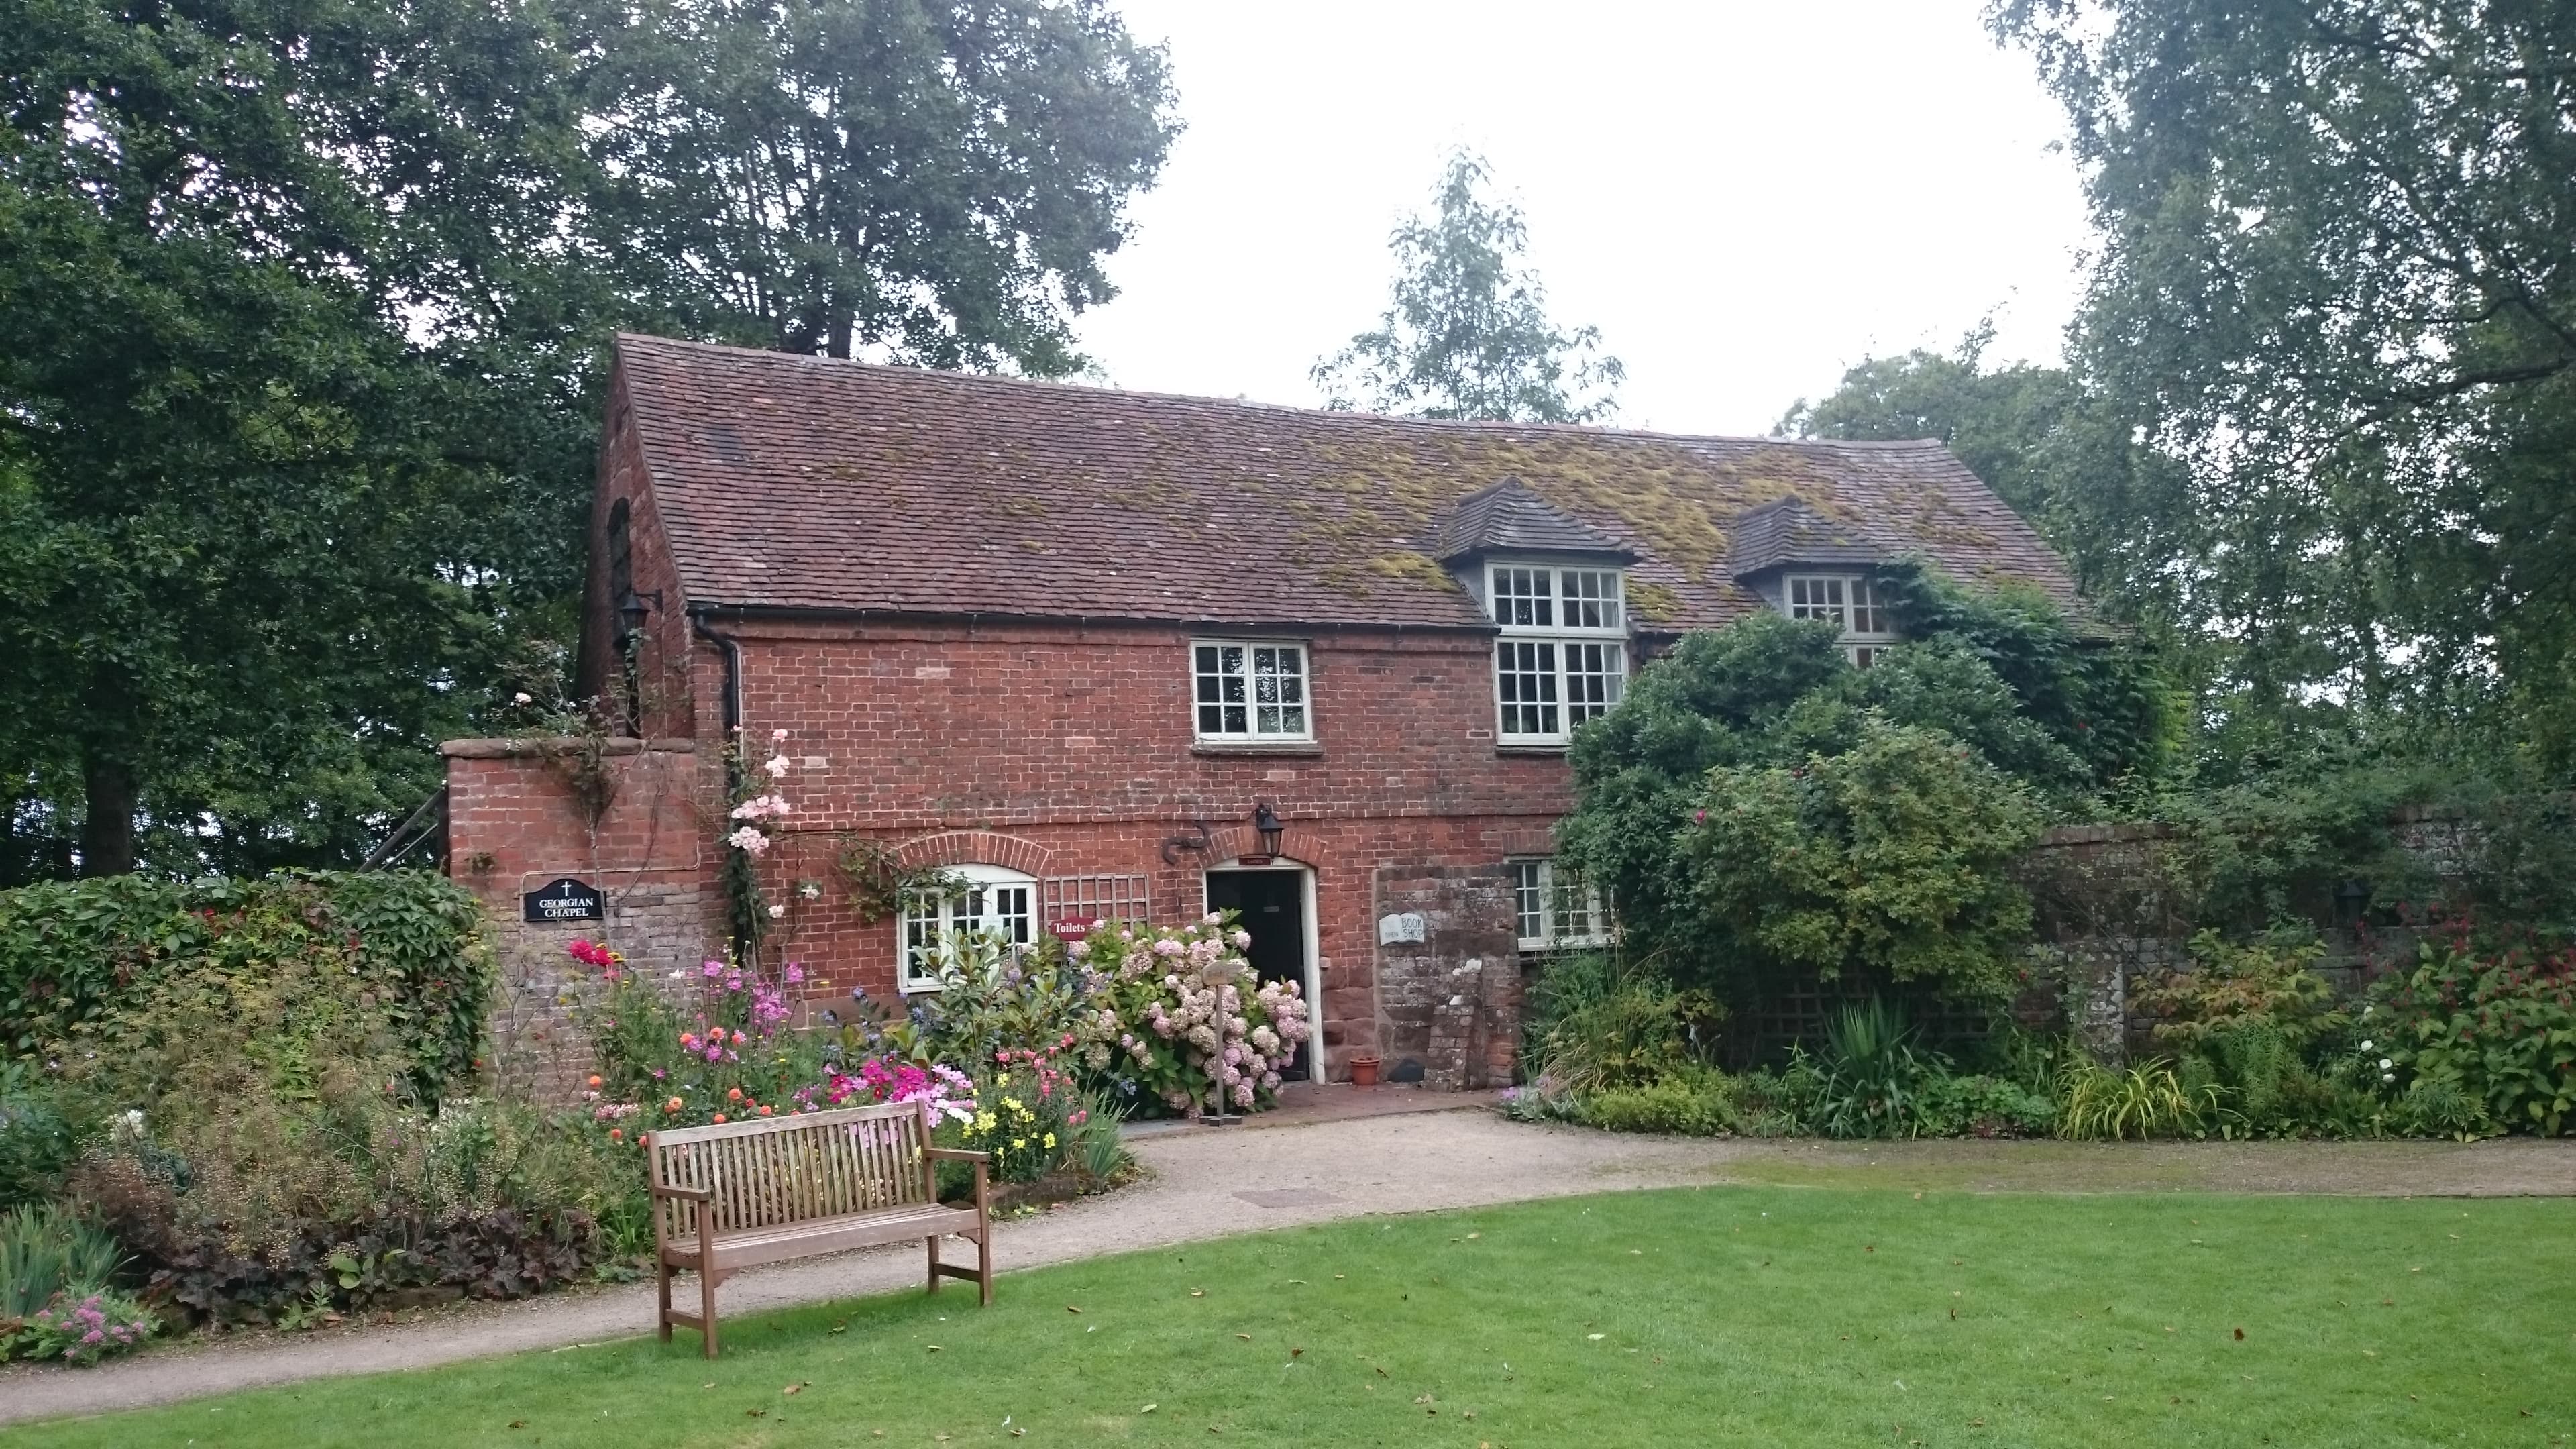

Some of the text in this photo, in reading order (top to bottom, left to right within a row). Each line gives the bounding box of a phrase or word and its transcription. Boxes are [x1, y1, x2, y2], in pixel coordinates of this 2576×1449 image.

[539, 898, 594, 908] GEORGIAN
[544, 908, 589, 918] CHAPEL
[1054, 922, 1085, 933] Toilets
[1401, 917, 1422, 928] BOOK
[1403, 928, 1424, 938] SHOP
